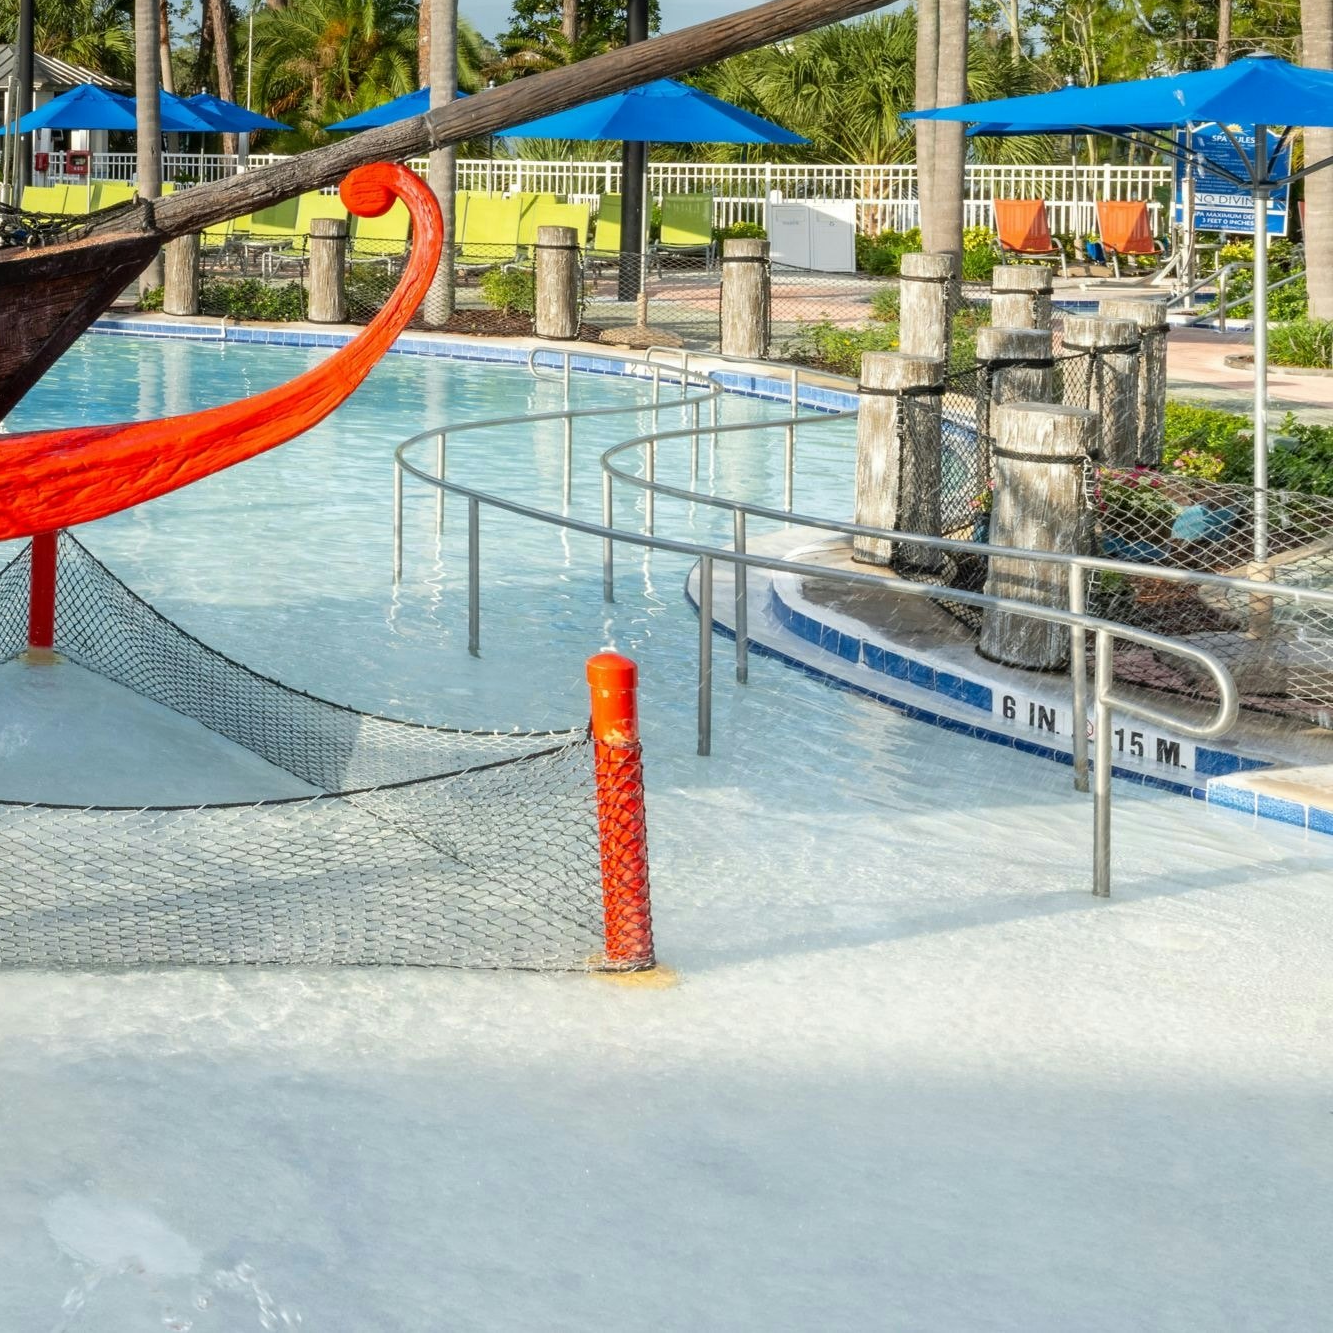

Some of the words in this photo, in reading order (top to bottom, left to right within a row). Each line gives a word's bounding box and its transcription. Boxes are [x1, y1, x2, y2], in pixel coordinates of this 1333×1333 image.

[1229, 136, 1255, 144] ULES
[1194, 194, 1214, 204] NO
[1218, 195, 1255, 206] DIVIN
[1003, 695, 1016, 719] 6
[1030, 702, 1060, 735] IN.
[1156, 738, 1187, 769] M.
